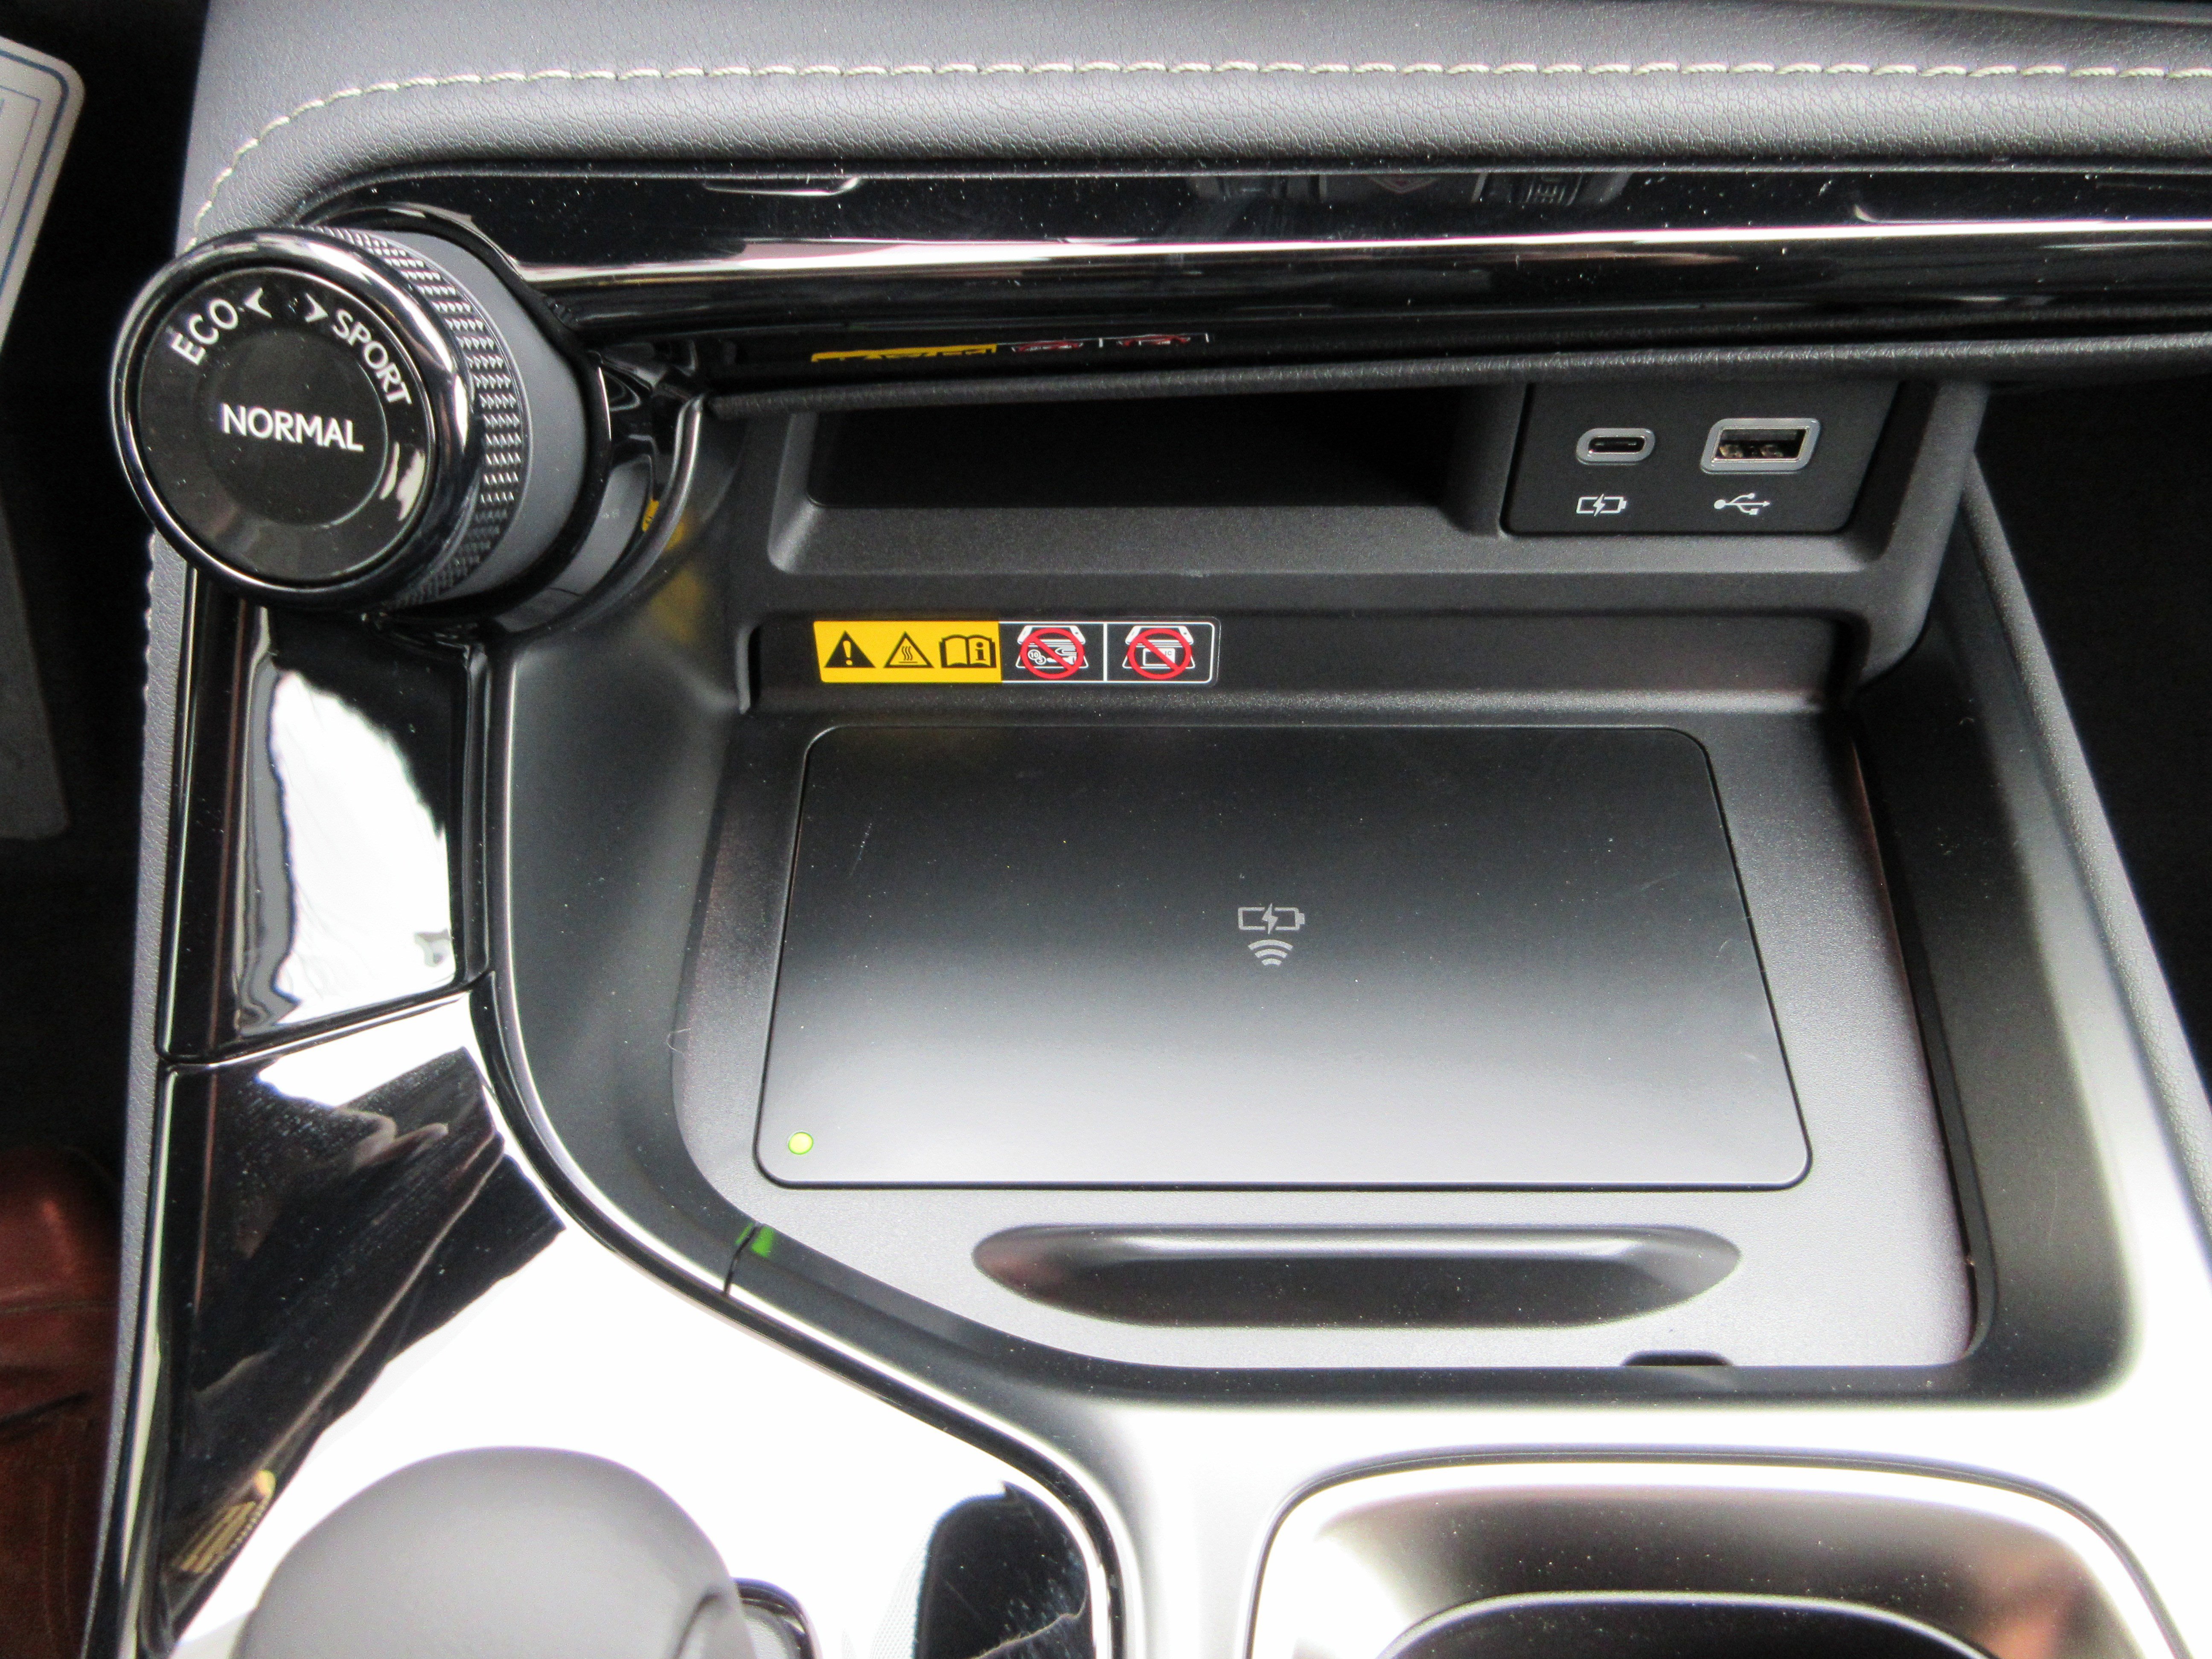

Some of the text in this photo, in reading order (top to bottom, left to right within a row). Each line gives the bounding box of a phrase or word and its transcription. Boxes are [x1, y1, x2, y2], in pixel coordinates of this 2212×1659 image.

[169, 299, 238, 365] ECO
[332, 309, 412, 404] SPORT
[221, 403, 364, 451] NORMAL
